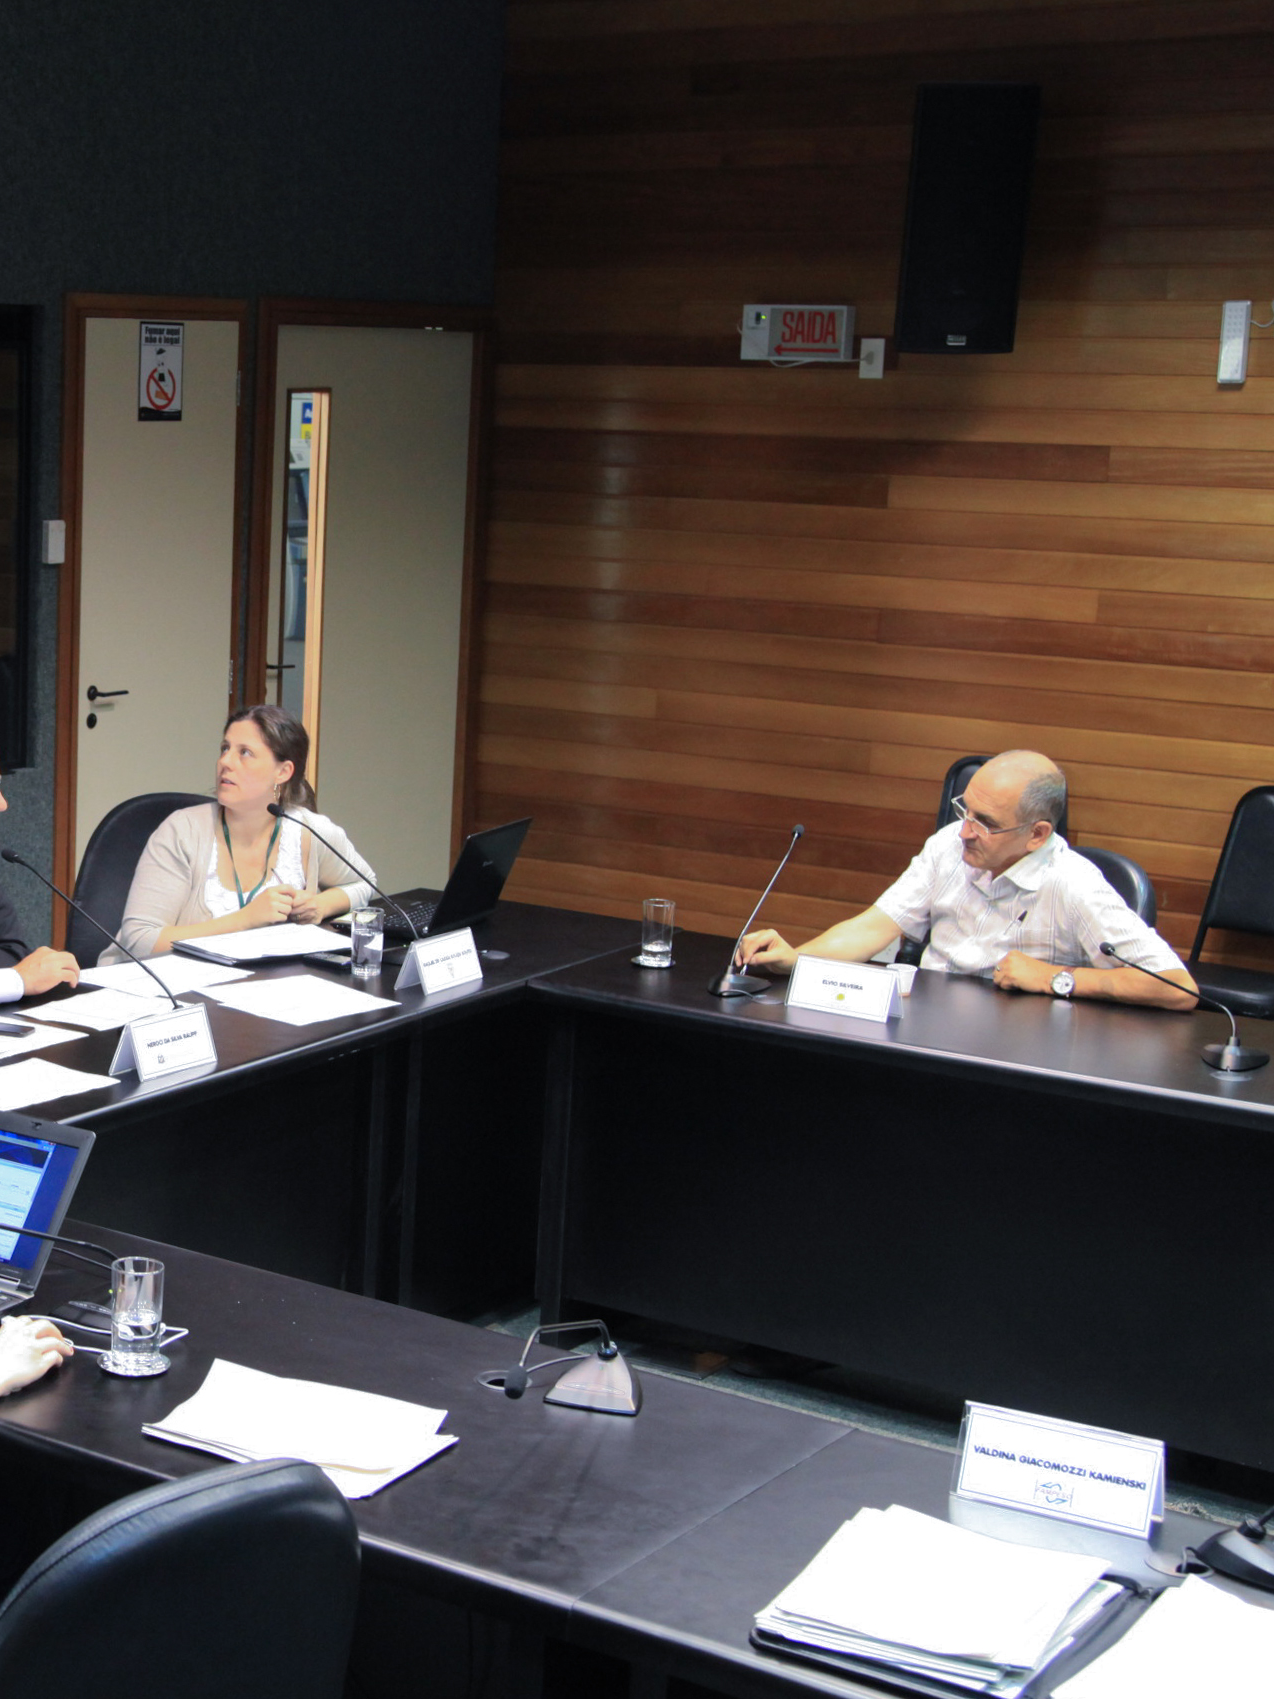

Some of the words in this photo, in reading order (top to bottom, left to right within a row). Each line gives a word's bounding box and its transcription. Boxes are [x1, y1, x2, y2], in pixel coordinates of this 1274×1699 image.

[973, 1444, 1016, 1462] VALDINA
[1019, 1454, 1087, 1477] GIACOMOZZI
[1089, 1470, 1146, 1491] KAMIENSKI
